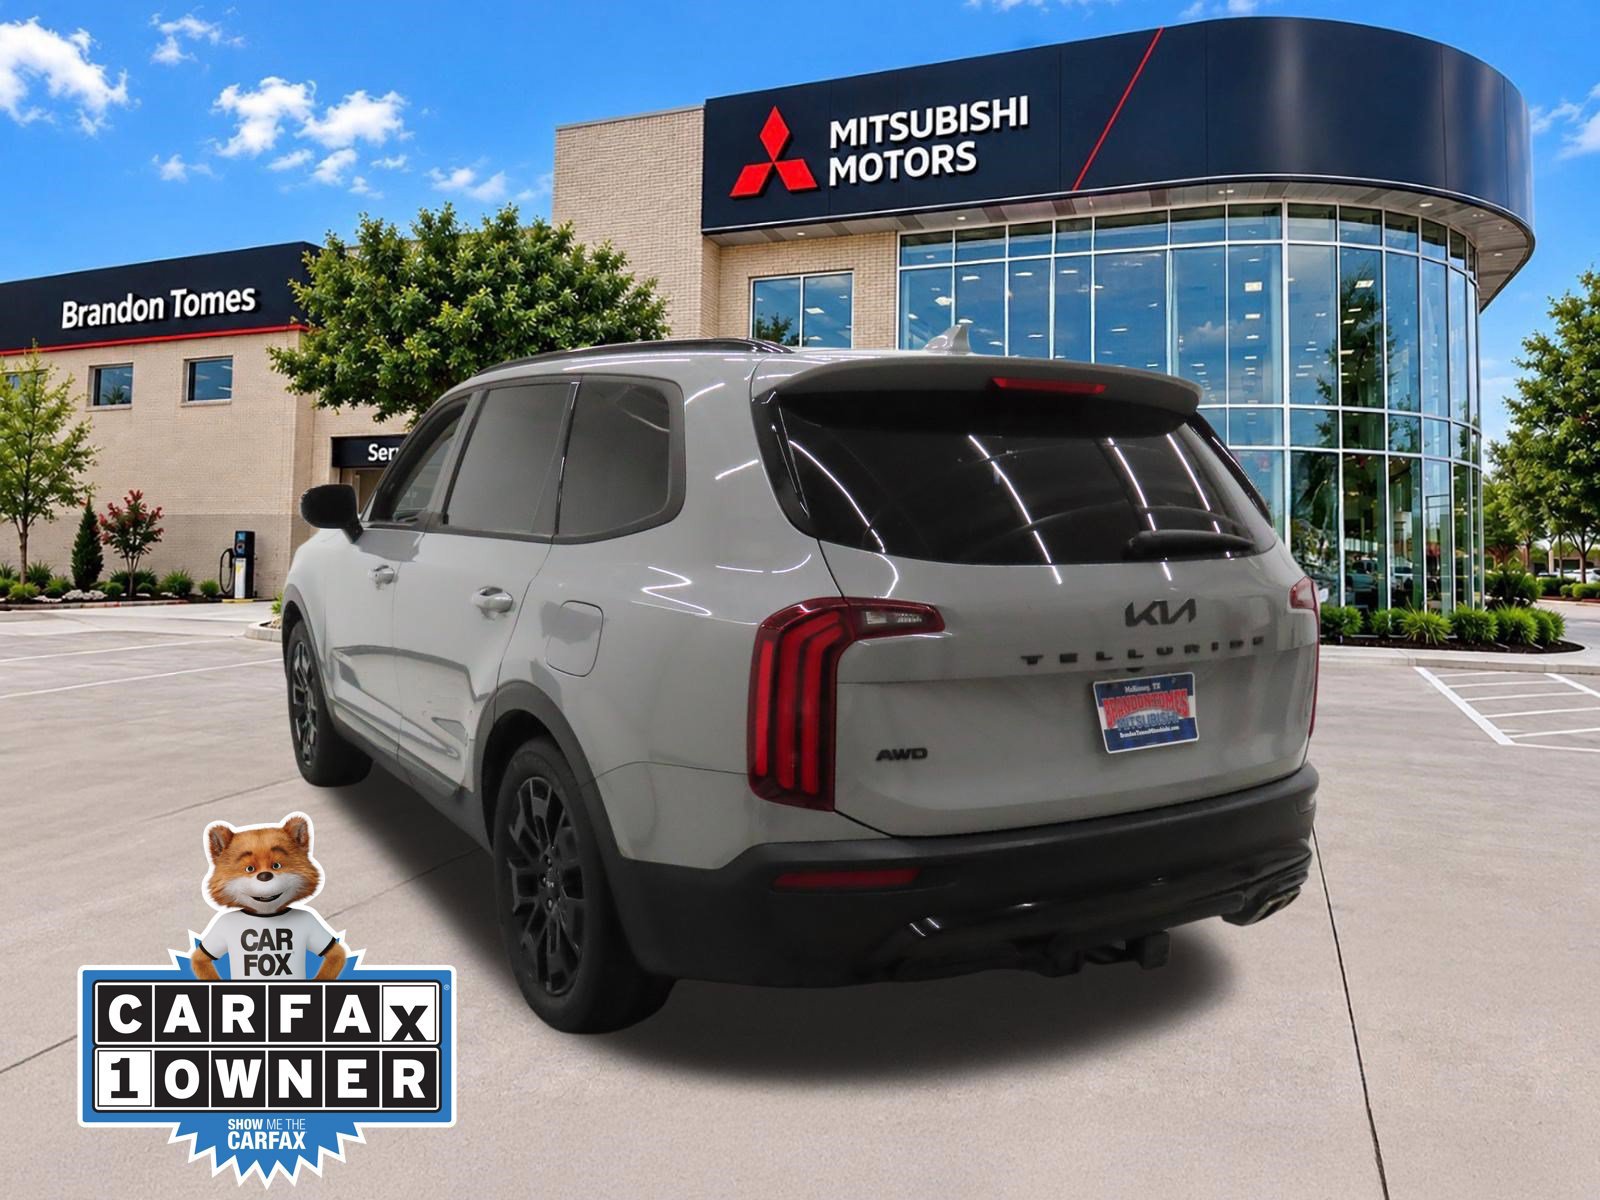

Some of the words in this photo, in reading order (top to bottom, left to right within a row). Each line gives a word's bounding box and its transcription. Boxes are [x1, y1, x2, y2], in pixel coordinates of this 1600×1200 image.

[829, 95, 1029, 149] MITSUBISHI
[828, 140, 978, 187] MOTORS
[61, 293, 165, 330] Brandon
[170, 287, 256, 318] Tomes
[1125, 598, 1196, 627] KIA
[1021, 636, 1265, 665] TELLURIDE
[1152, 682, 1161, 690] TX
[876, 747, 928, 761] AWD
